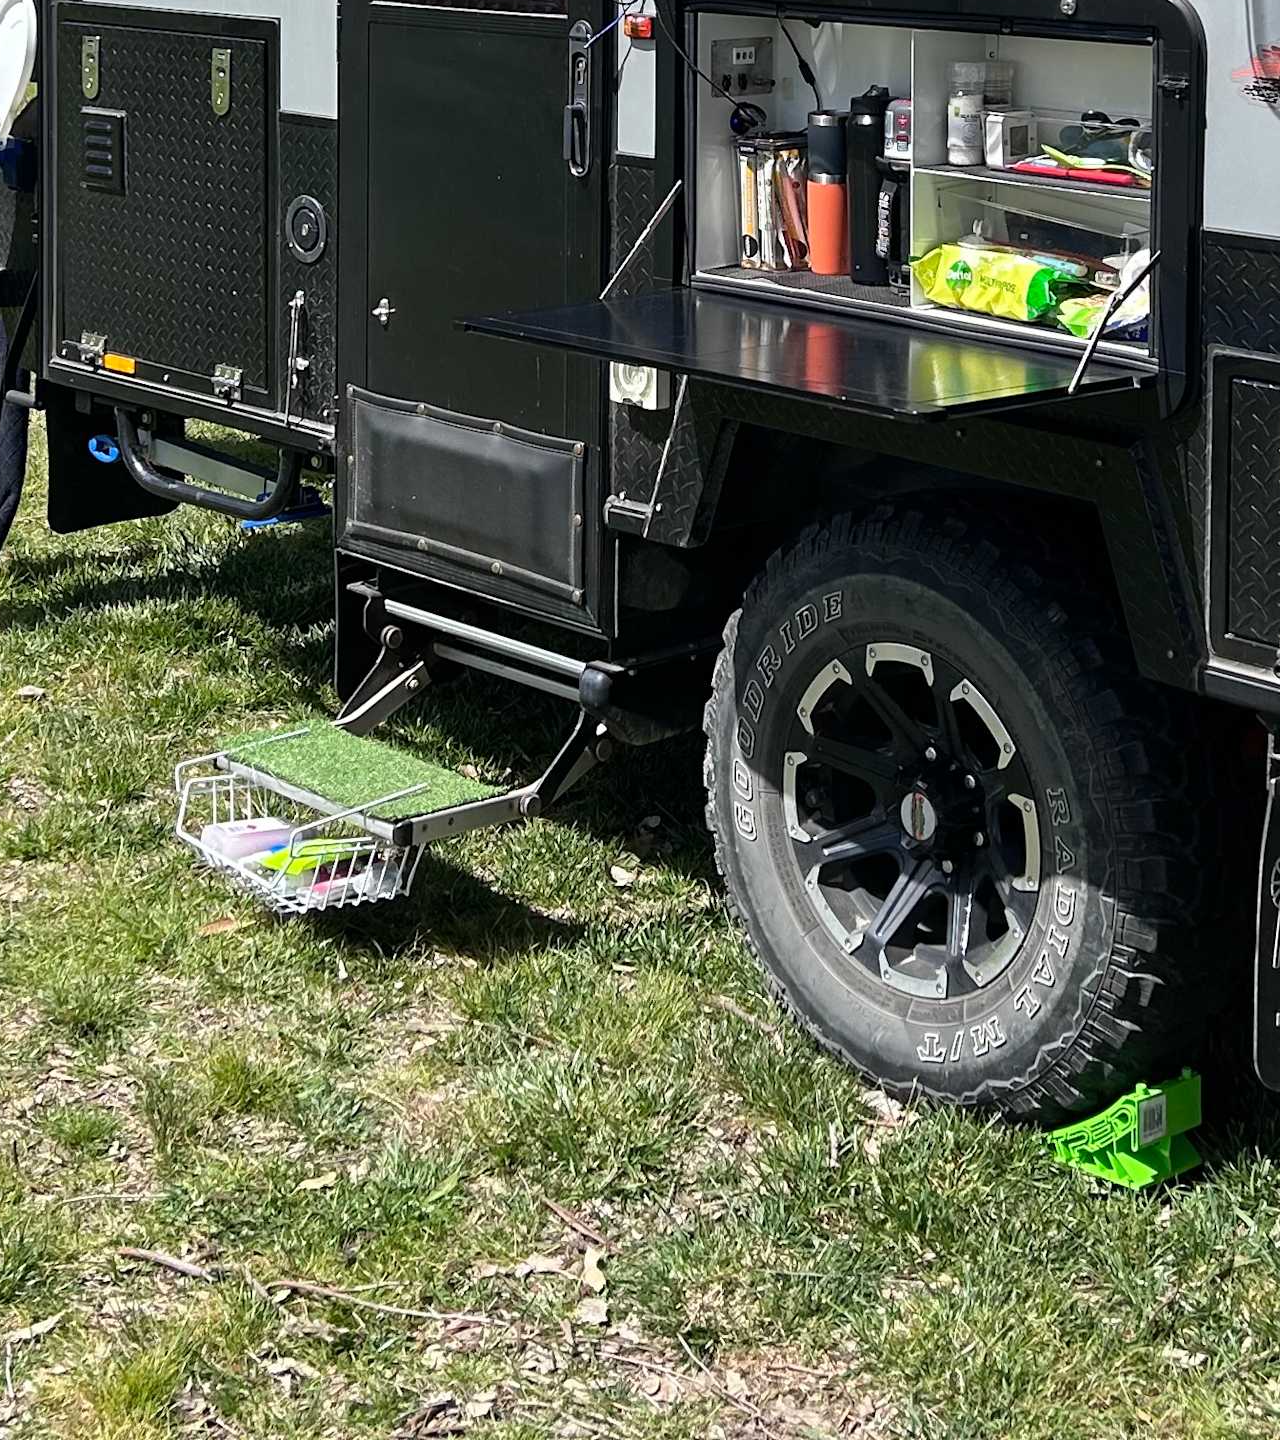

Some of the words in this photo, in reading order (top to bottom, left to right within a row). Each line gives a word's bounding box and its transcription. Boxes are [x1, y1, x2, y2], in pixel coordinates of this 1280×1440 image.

[731, 589, 844, 842] GOODRIDE
[1012, 786, 1079, 1021] RADIAL
[916, 1014, 1008, 1065] M/T
